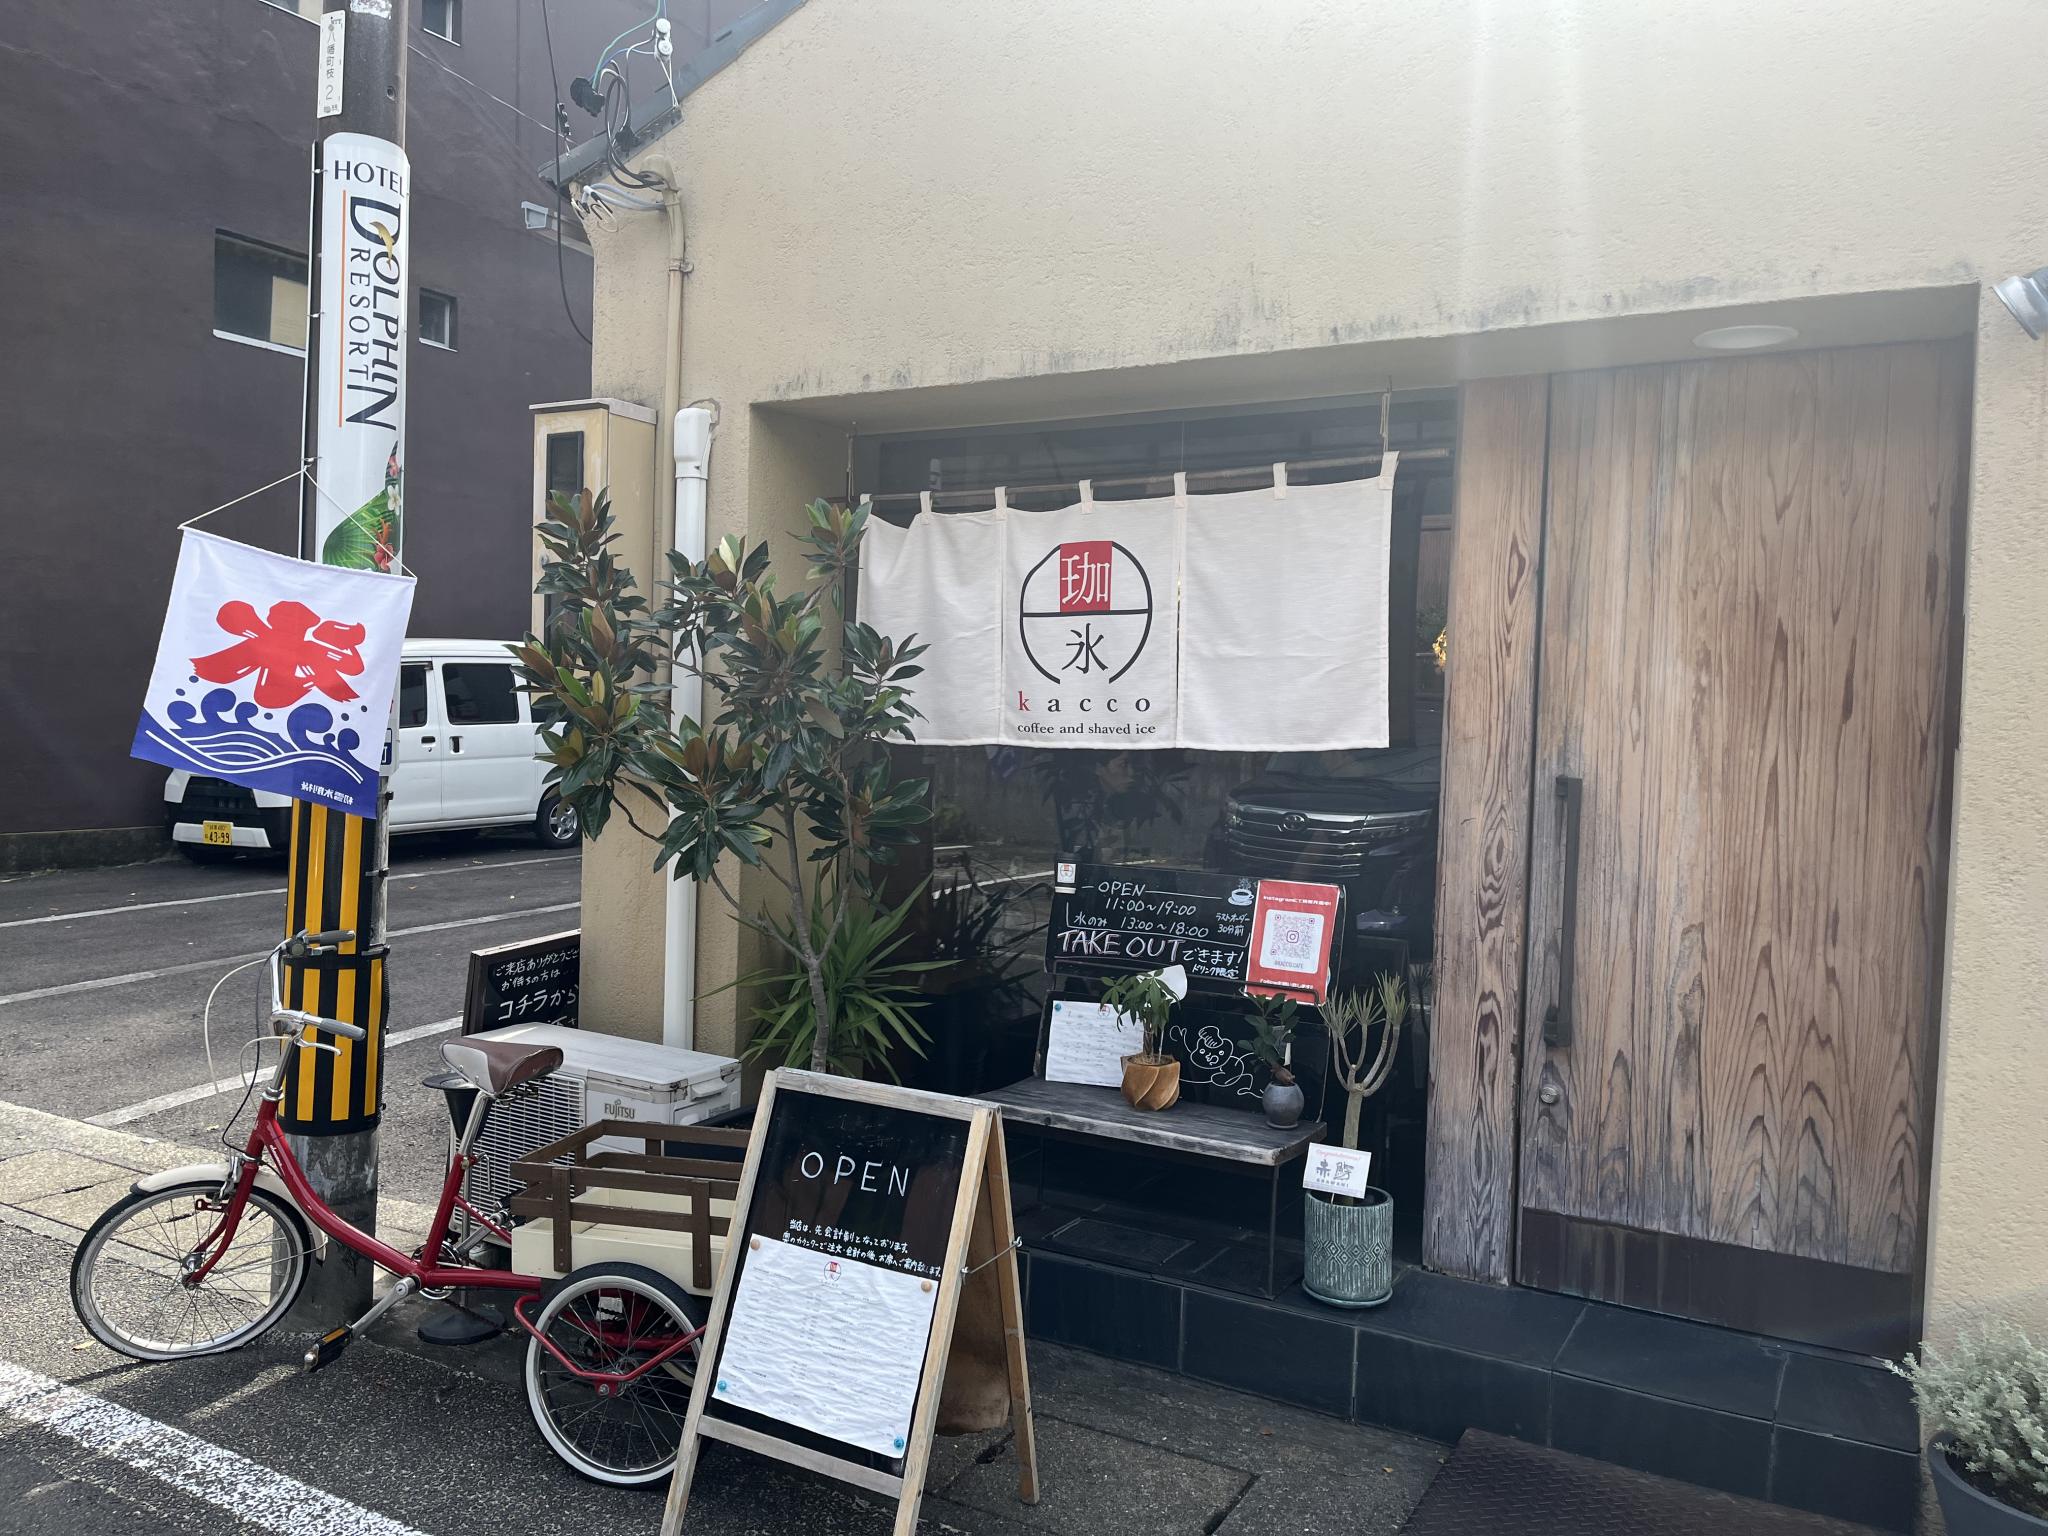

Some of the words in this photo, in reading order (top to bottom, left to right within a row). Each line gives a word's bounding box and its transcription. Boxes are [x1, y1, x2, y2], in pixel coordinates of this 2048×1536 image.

[325, 84, 334, 100] 2
[334, 160, 405, 198] HOTEL
[345, 196, 401, 431] DOLPHIN
[349, 247, 371, 381] RESORT
[189, 600, 366, 709] 氷
[1062, 622, 1109, 674] 氷
[1017, 722, 1054, 735] coffee
[1059, 722, 1084, 734] and
[1088, 722, 1131, 735] shaved
[1135, 723, 1156, 734] ice
[1098, 881, 1146, 897] OPEN
[1057, 929, 1121, 956] TAKE
[1125, 936, 1186, 962] OUT
[604, 1102, 635, 1119] FUJITSU
[801, 1151, 909, 1197] OPEN
